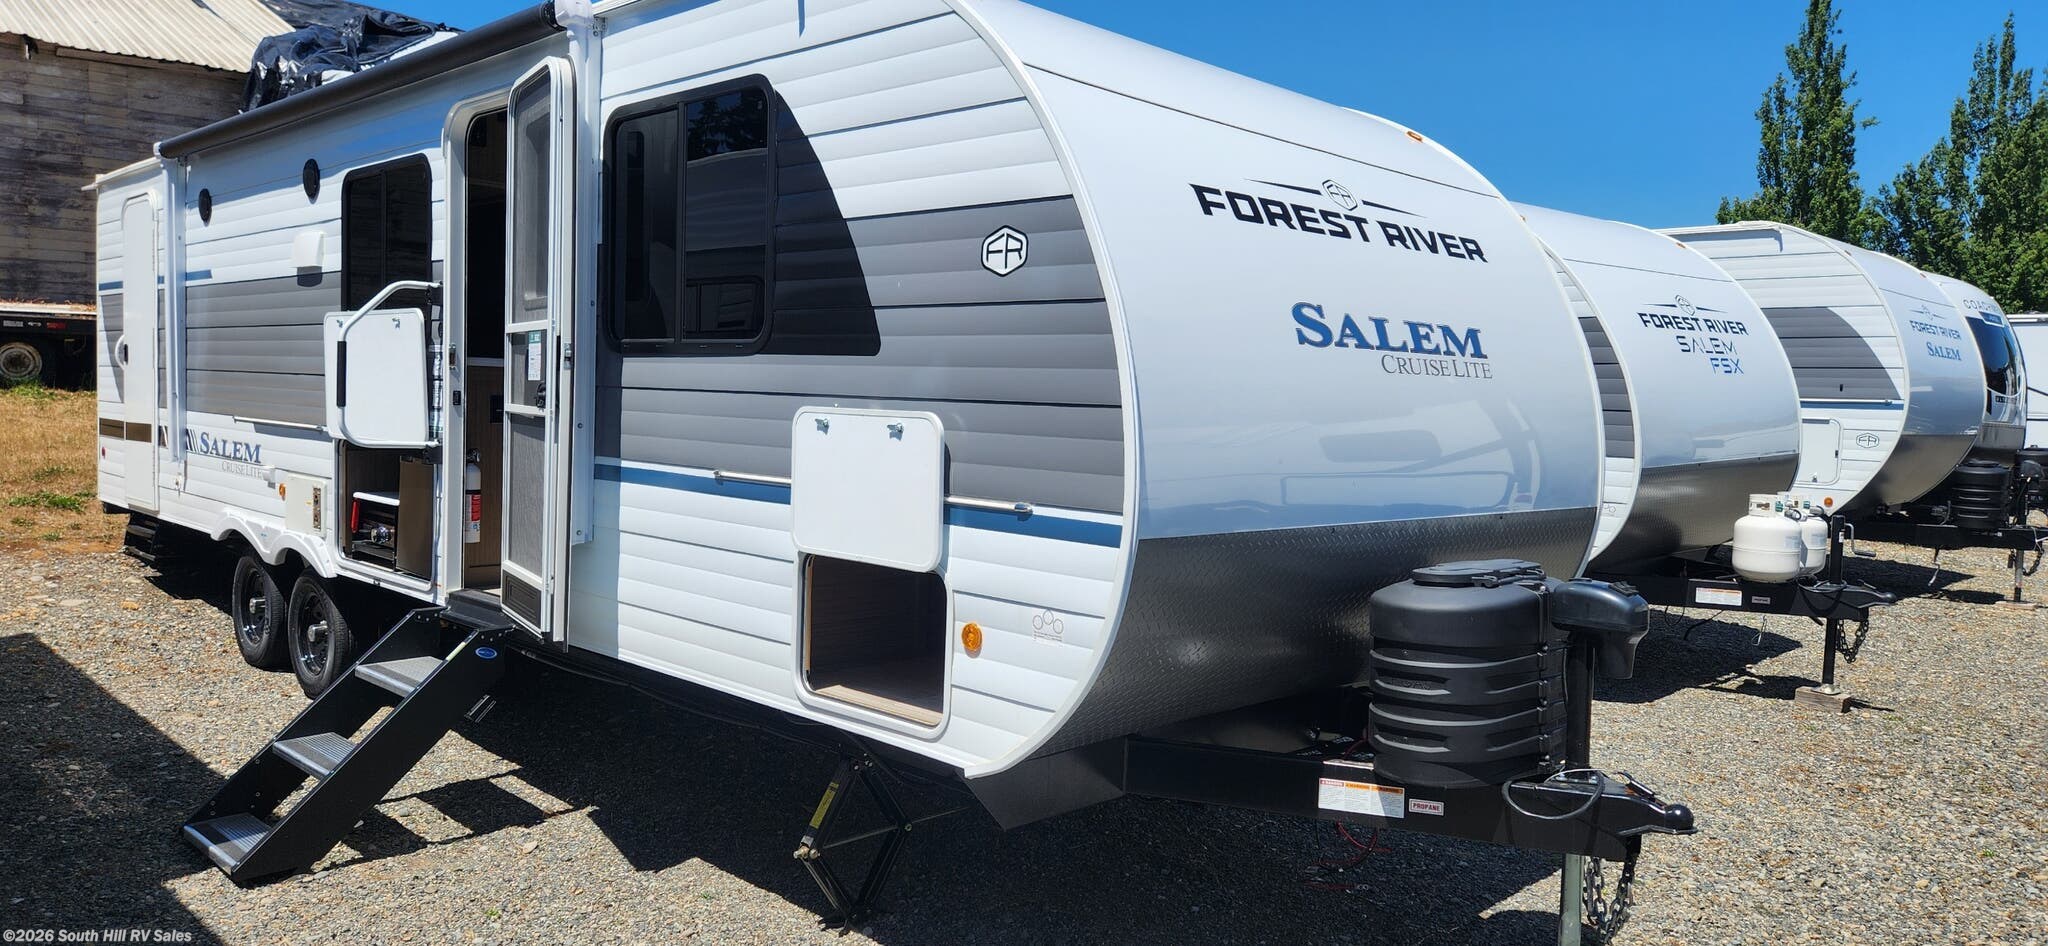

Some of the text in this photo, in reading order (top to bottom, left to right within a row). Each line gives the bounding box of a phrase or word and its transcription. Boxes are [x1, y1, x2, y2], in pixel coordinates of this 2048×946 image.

[1188, 182, 1489, 263] FOREST RIVER
[1290, 301, 1488, 360] SALEM
[1637, 312, 1749, 336] FOREST RIVER
[1676, 335, 1738, 355] SALEM
[1926, 341, 1962, 361] SALEM
[1709, 358, 1744, 374] FSX
[200, 432, 262, 463] SALEM
[1412, 802, 1441, 812] PROPANE
